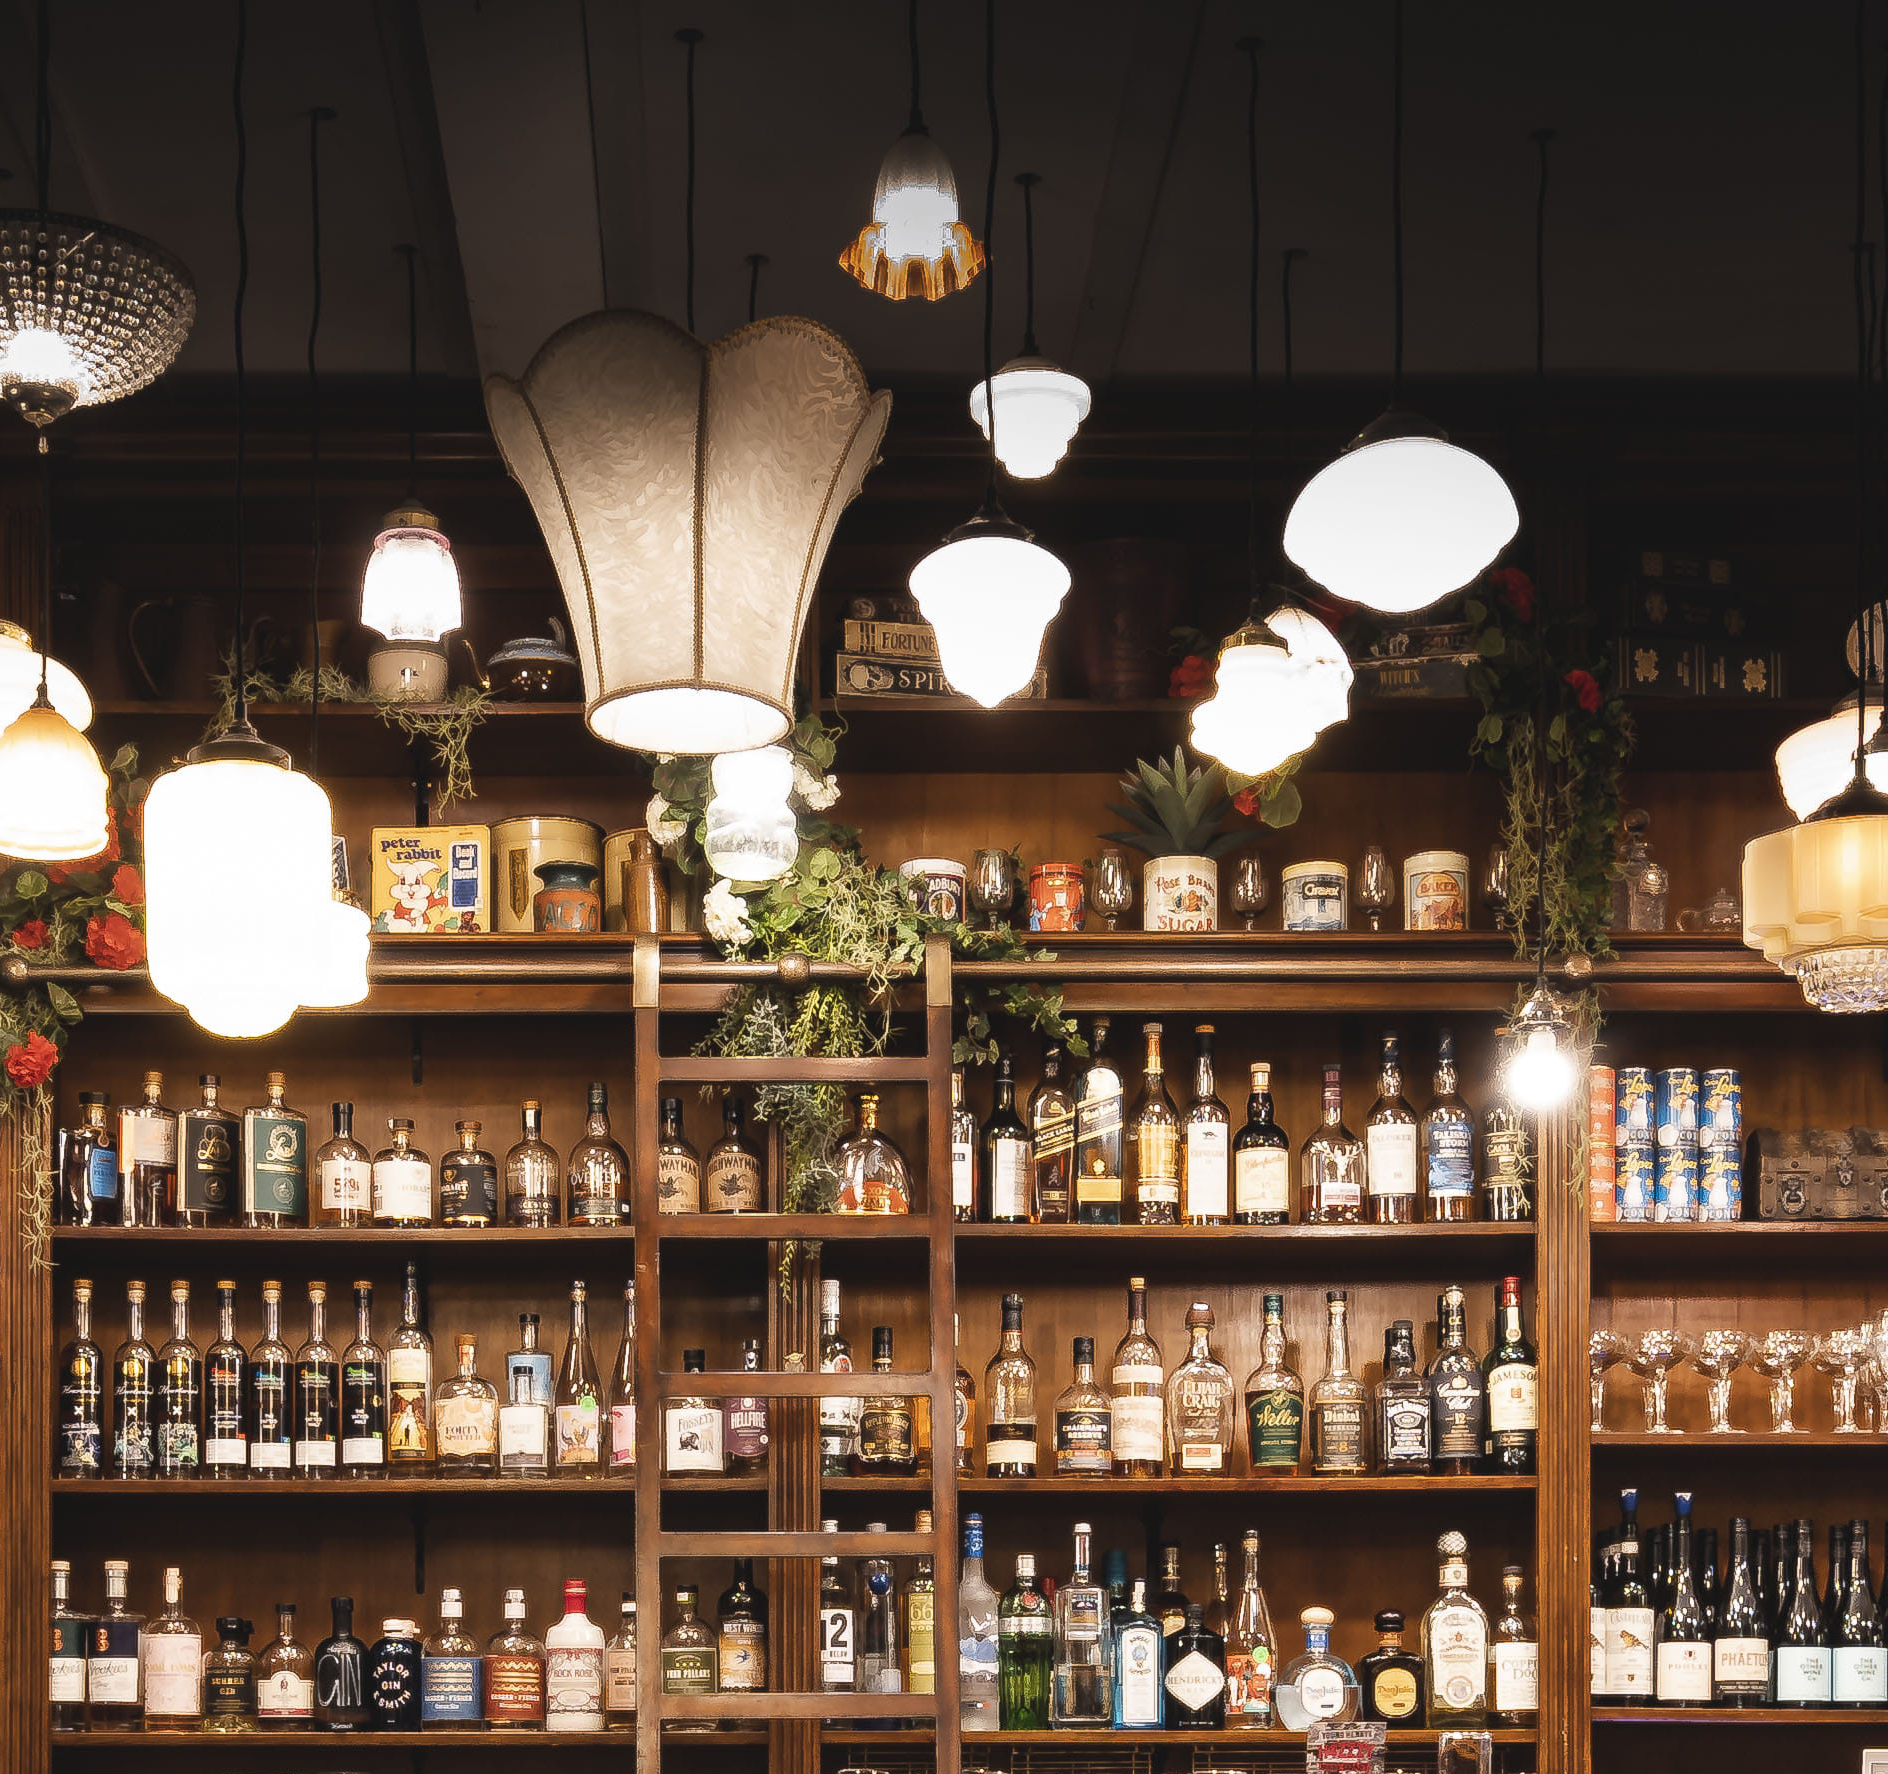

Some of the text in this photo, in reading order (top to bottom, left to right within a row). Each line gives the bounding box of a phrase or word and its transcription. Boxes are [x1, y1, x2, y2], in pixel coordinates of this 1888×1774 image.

[381, 838, 421, 852] peter
[396, 848, 442, 860] rabbit
[1420, 882, 1458, 893] BAKER
[1157, 915, 1216, 933] SUGAR
[1256, 1404, 1299, 1426] Weller
[317, 1653, 362, 1707] GIN
[373, 1662, 410, 1680] TAYLOR
[381, 1681, 401, 1690] GIN
[378, 1690, 411, 1709] SMITH
